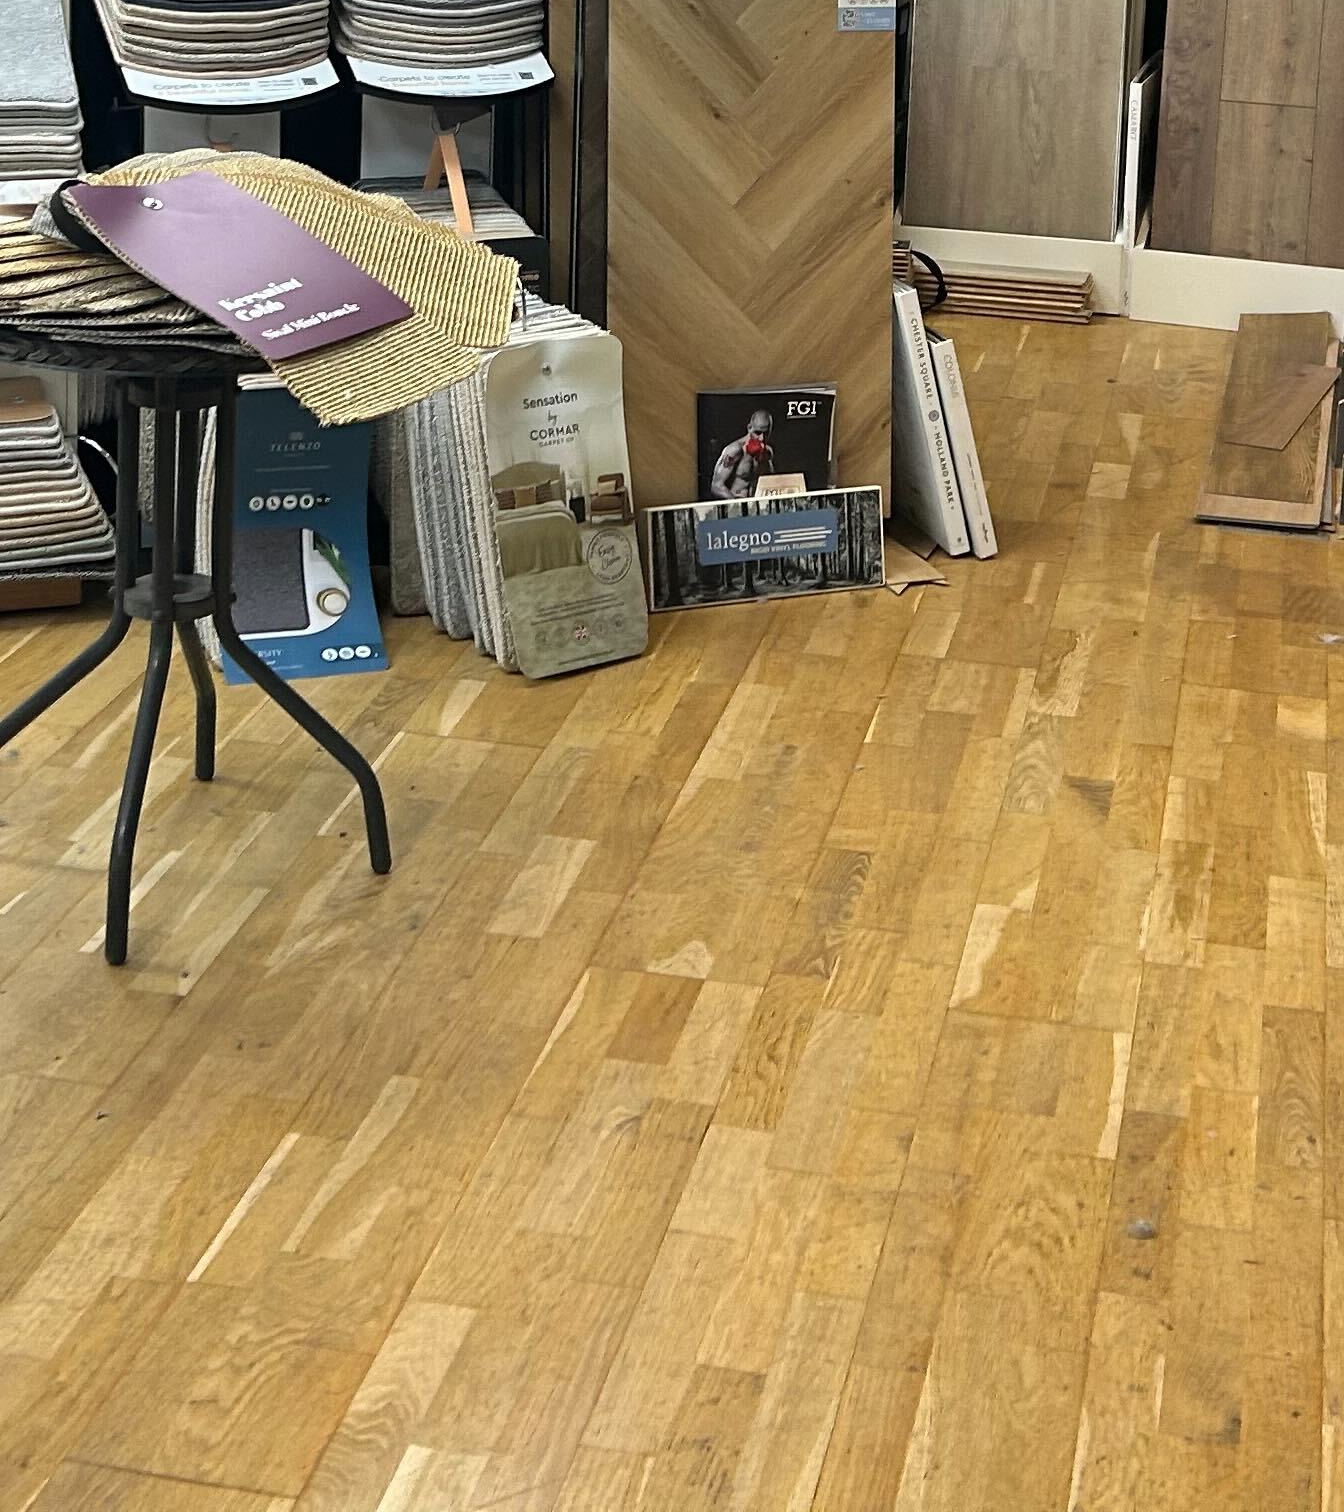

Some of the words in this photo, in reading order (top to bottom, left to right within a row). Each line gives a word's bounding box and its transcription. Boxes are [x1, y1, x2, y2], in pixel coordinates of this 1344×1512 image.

[522, 390, 578, 411] Sensation
[910, 318, 925, 360] CHESTER
[918, 361, 933, 399] SQUARE
[933, 431, 949, 479] HOLLAND
[943, 478, 955, 504] PARK
[547, 410, 559, 426] by
[529, 423, 581, 442] CORMAR
[707, 530, 772, 553] lalegno
